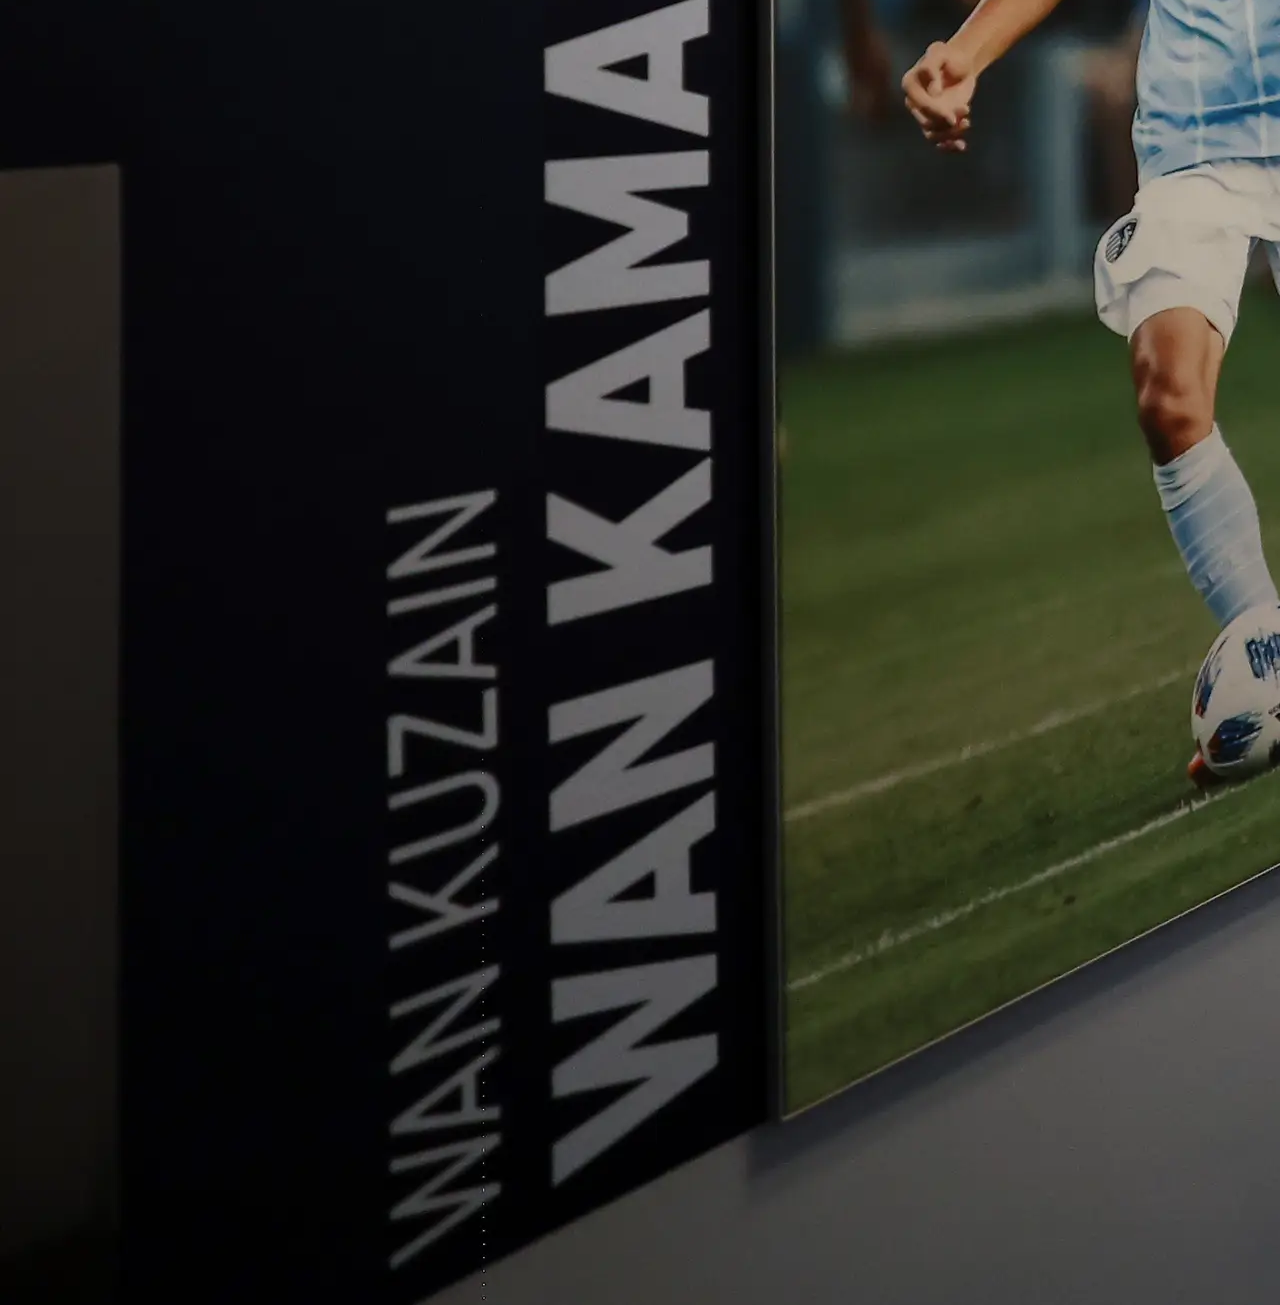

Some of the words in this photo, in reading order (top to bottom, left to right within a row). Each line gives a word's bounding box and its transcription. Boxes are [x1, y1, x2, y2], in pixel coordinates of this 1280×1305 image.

[386, 488, 501, 952] KUZAIN
[548, 656, 719, 1190] WAN
[388, 962, 503, 1270] WAN
